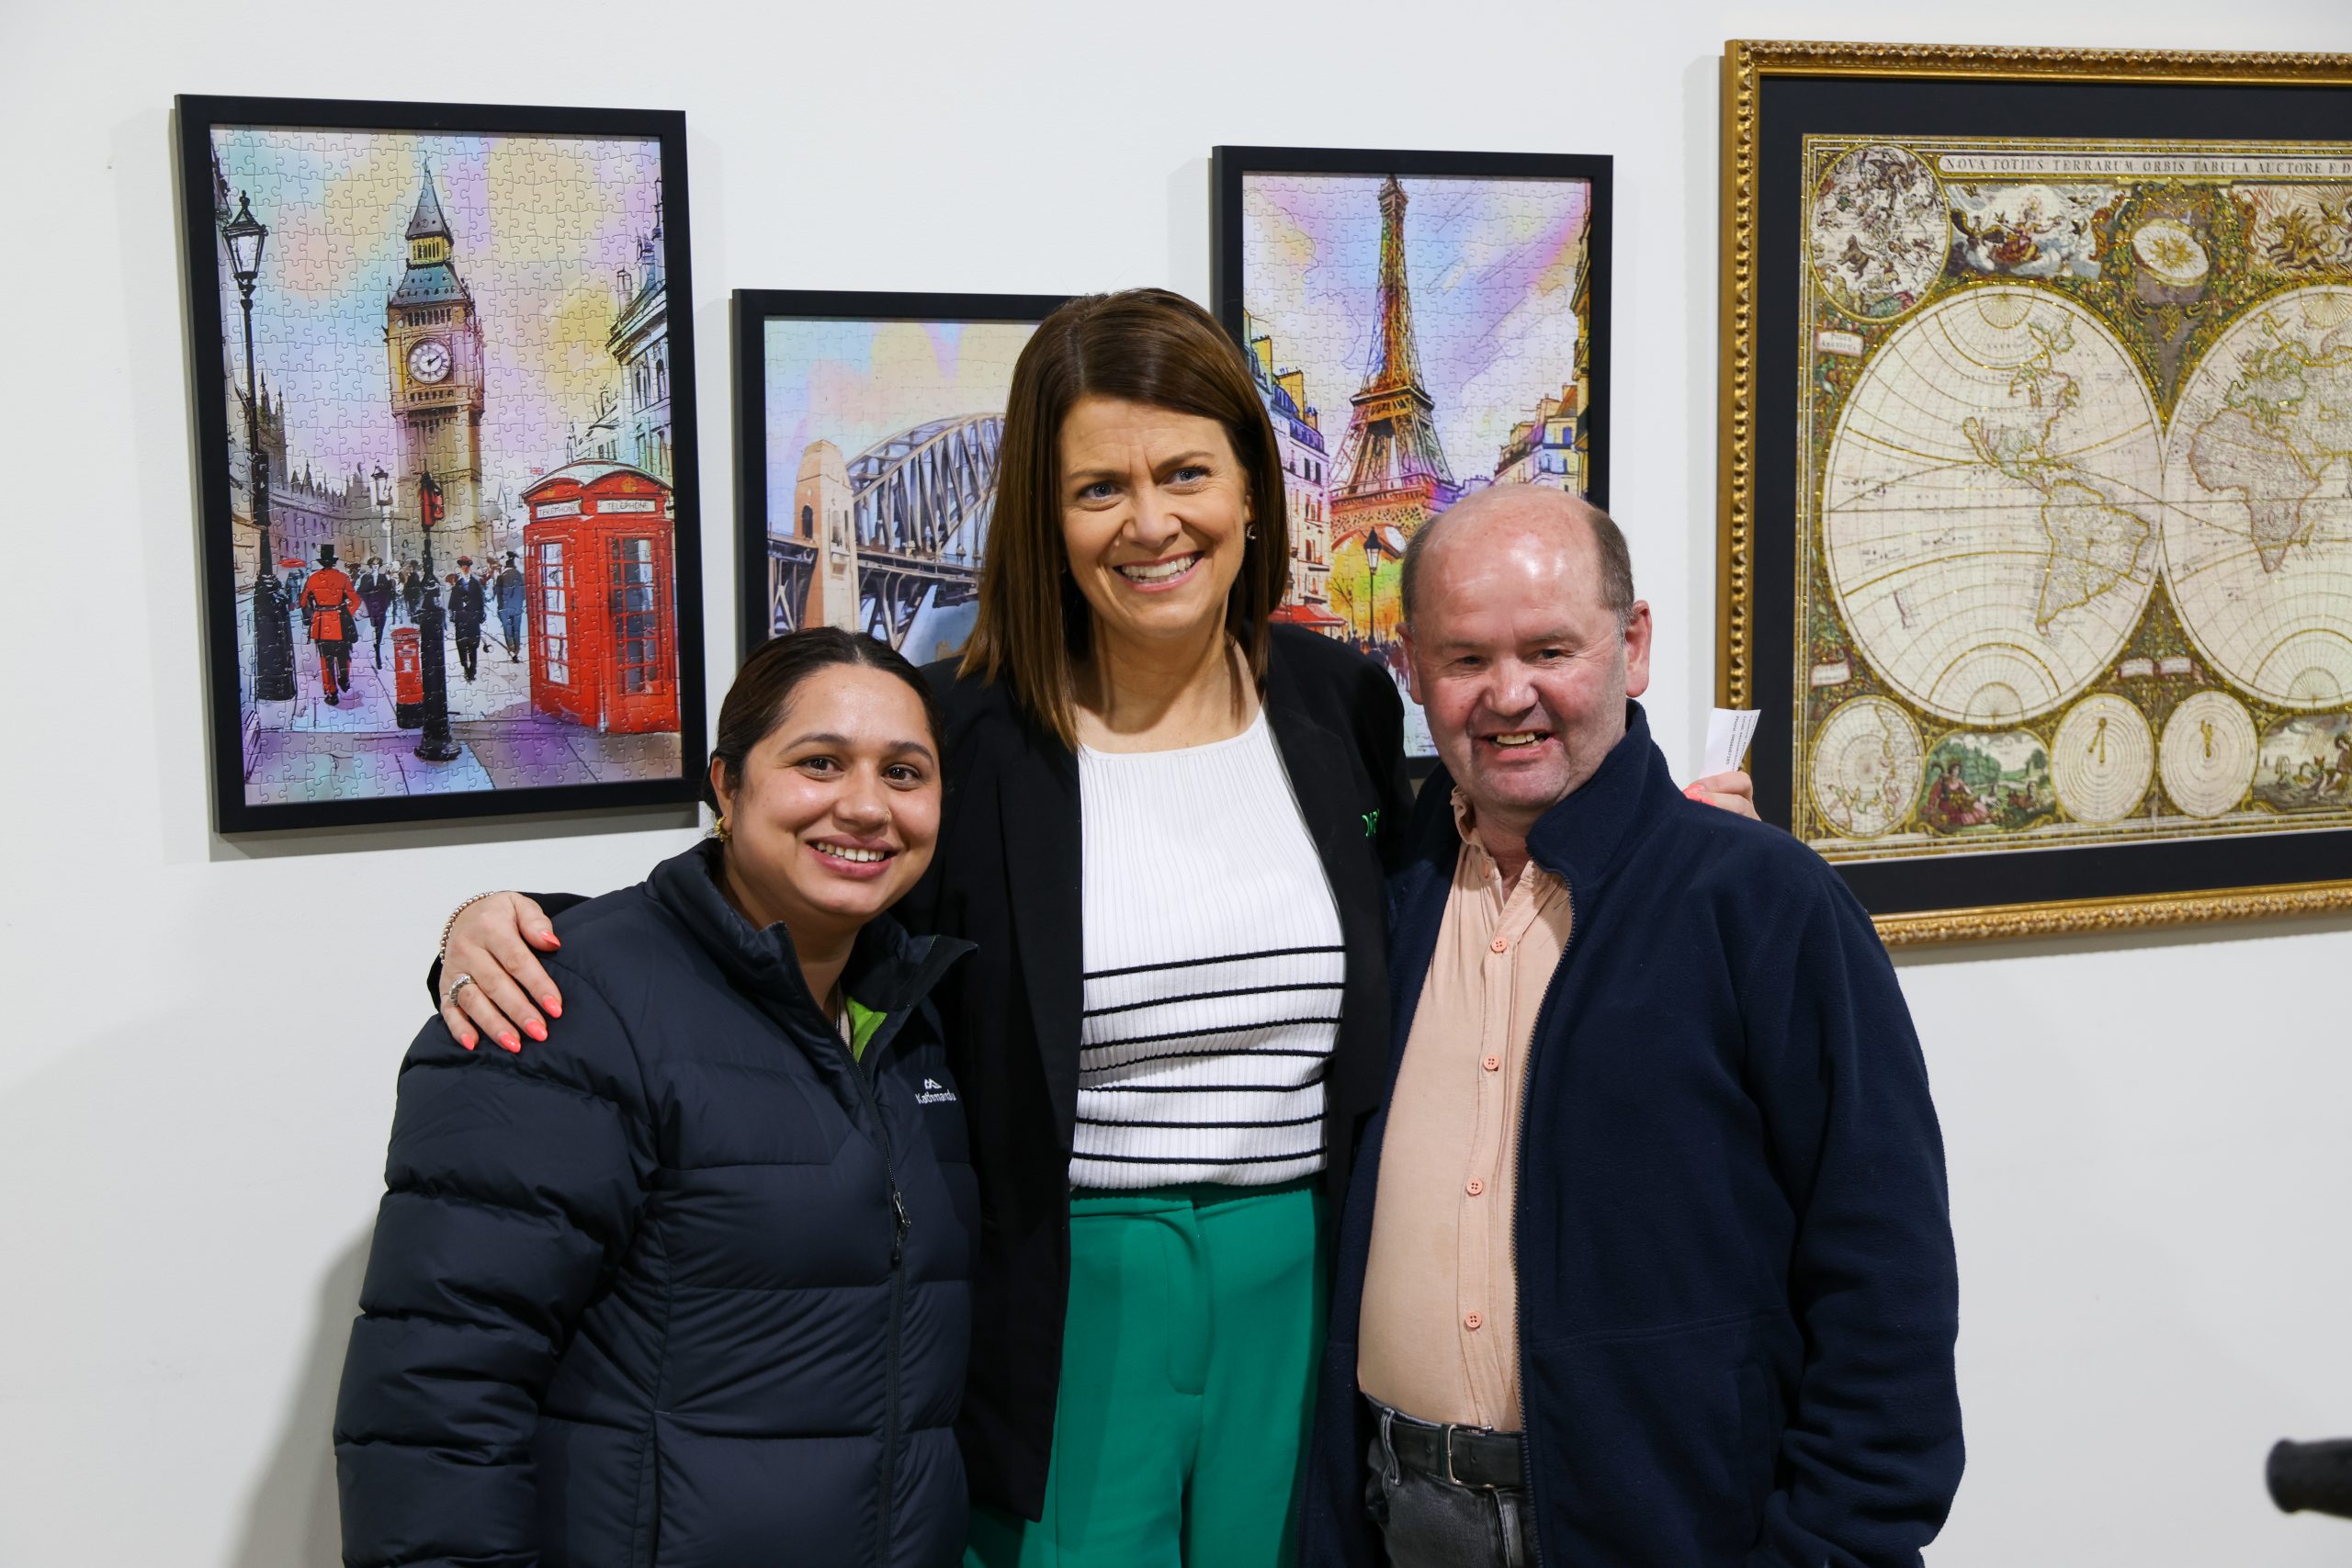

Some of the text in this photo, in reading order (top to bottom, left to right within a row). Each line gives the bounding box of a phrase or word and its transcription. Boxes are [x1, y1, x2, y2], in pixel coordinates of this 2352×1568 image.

[1946, 158, 1985, 170] NOVA
[2052, 160, 2133, 173] TERRARUM
[2143, 160, 2185, 173] ORBIS
[2193, 161, 2249, 174] TABULA
[915, 1089, 956, 1104] Kathmandu
